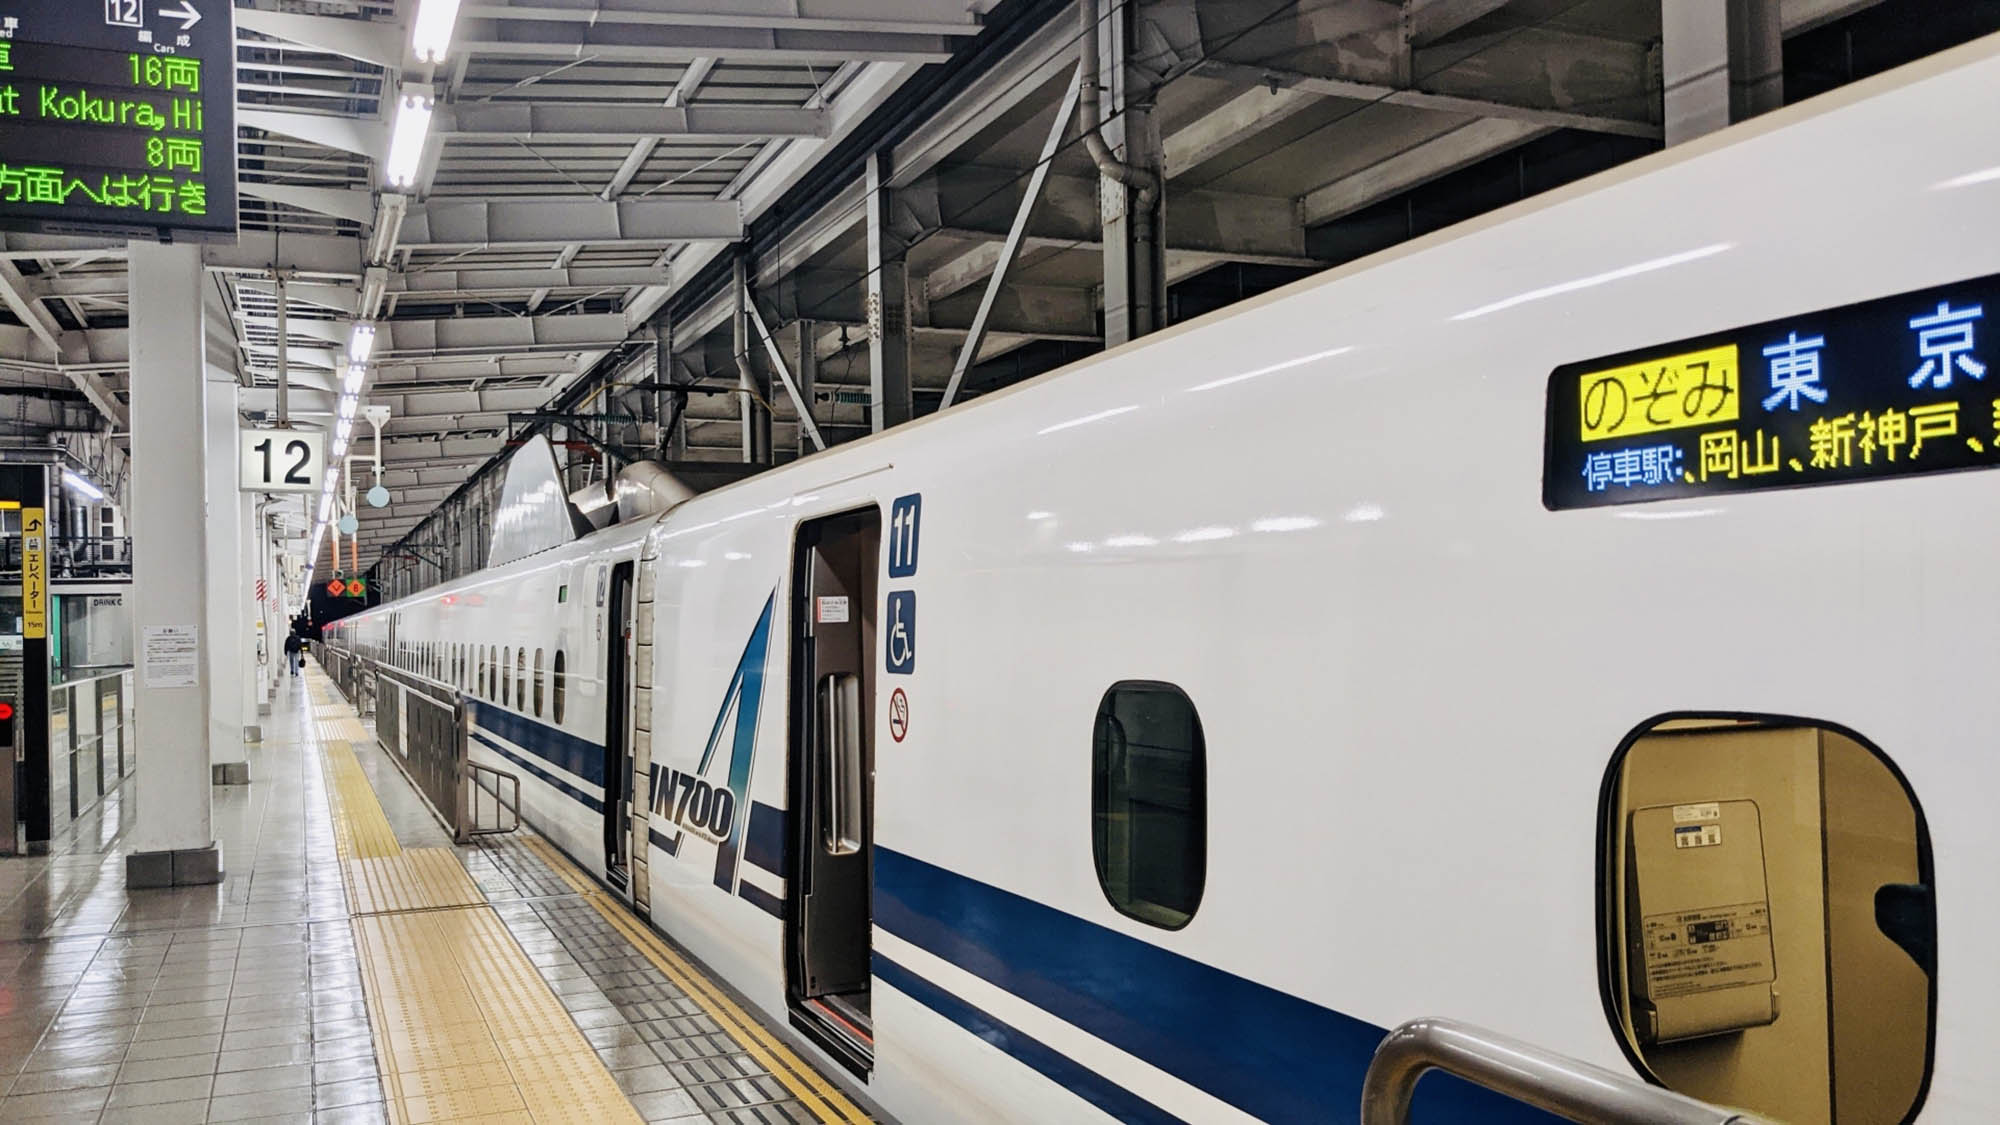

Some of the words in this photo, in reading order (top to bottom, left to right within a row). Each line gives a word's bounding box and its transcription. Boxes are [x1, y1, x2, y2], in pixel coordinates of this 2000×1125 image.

[110, 0, 138, 23] 12
[153, 43, 175, 54] Cars
[128, 53, 201, 93] 16両
[40, 86, 165, 131] Kokura,
[146, 137, 202, 173] 8両
[0, 163, 207, 215] 方面へは行き
[1584, 361, 1734, 432] のぞみ
[254, 438, 311, 484] 12
[893, 504, 916, 568] 11
[29, 554, 40, 608] エレベーター
[655, 765, 734, 838] N700
